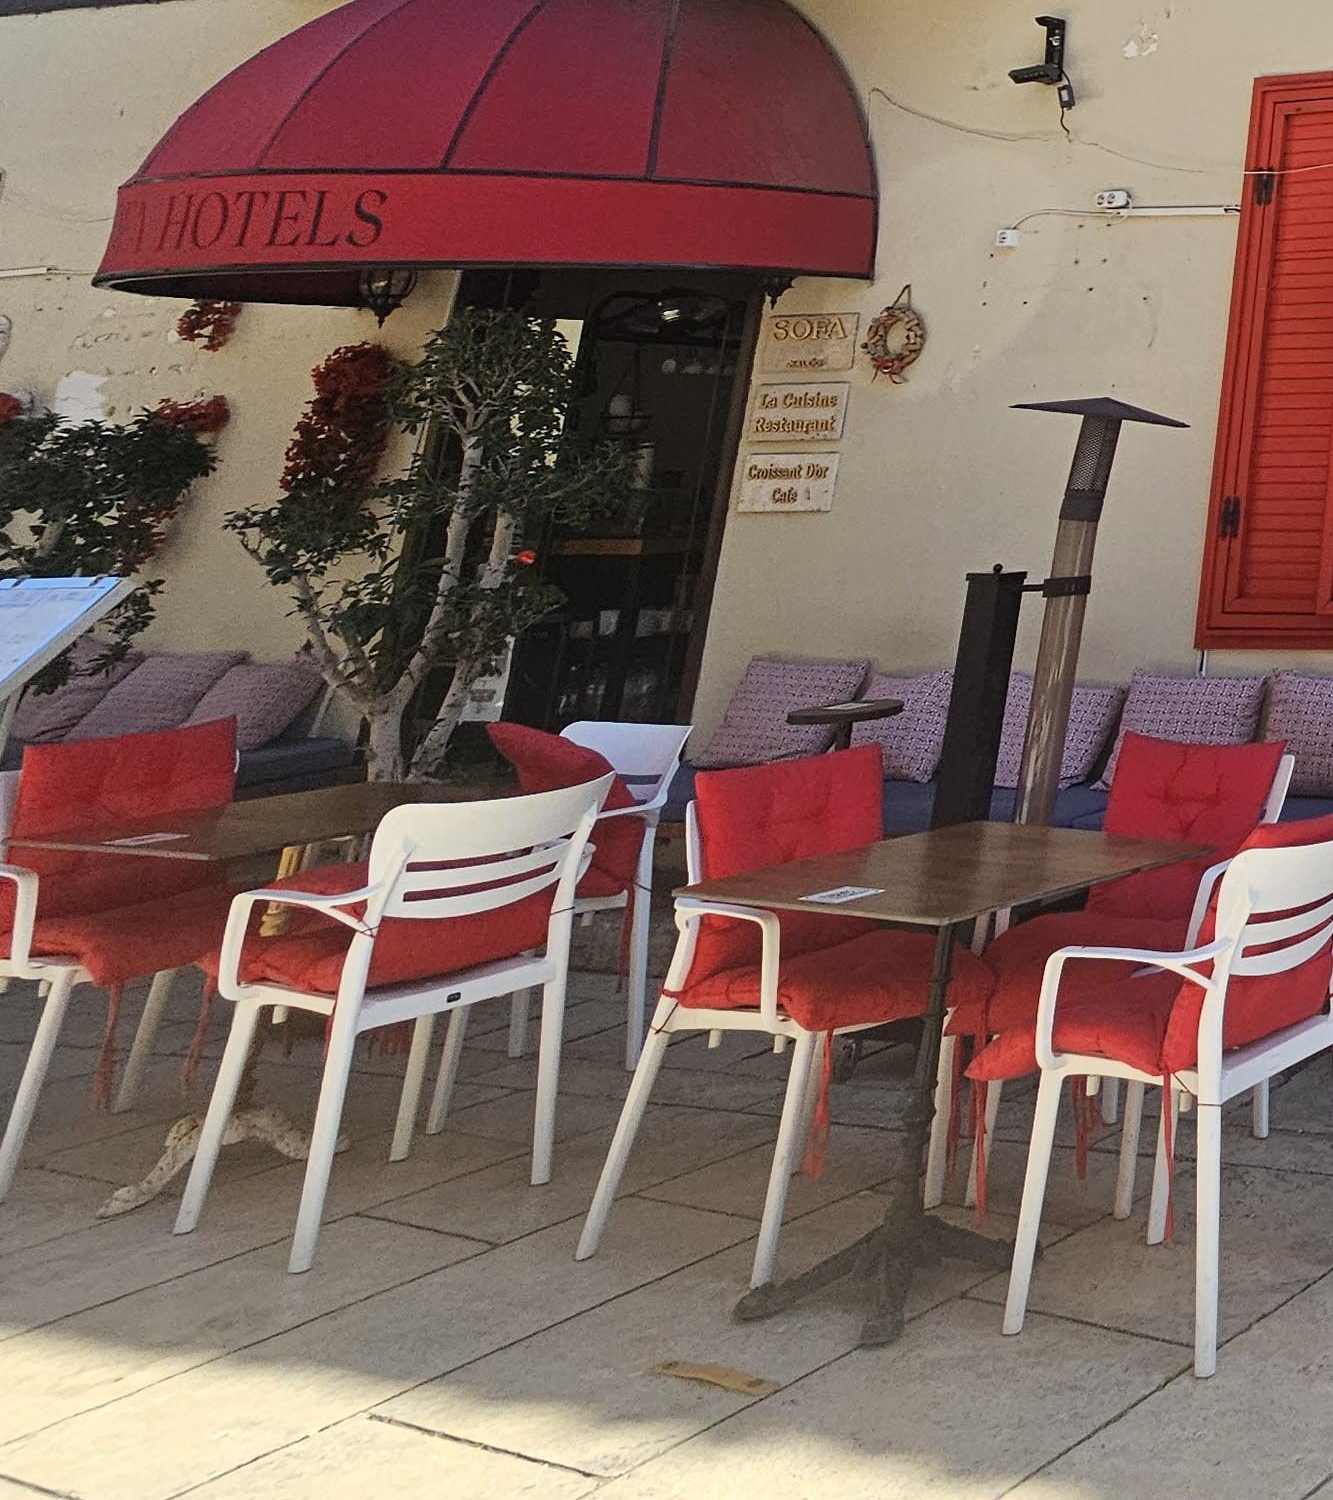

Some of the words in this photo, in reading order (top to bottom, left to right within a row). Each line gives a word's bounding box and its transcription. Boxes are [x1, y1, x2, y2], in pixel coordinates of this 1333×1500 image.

[157, 188, 389, 250] HOTELS
[773, 317, 847, 341] SOFA
[760, 393, 778, 409] La
[783, 391, 838, 409] Cuisine
[755, 416, 836, 434] Restaurant
[747, 463, 803, 480] Croissant
